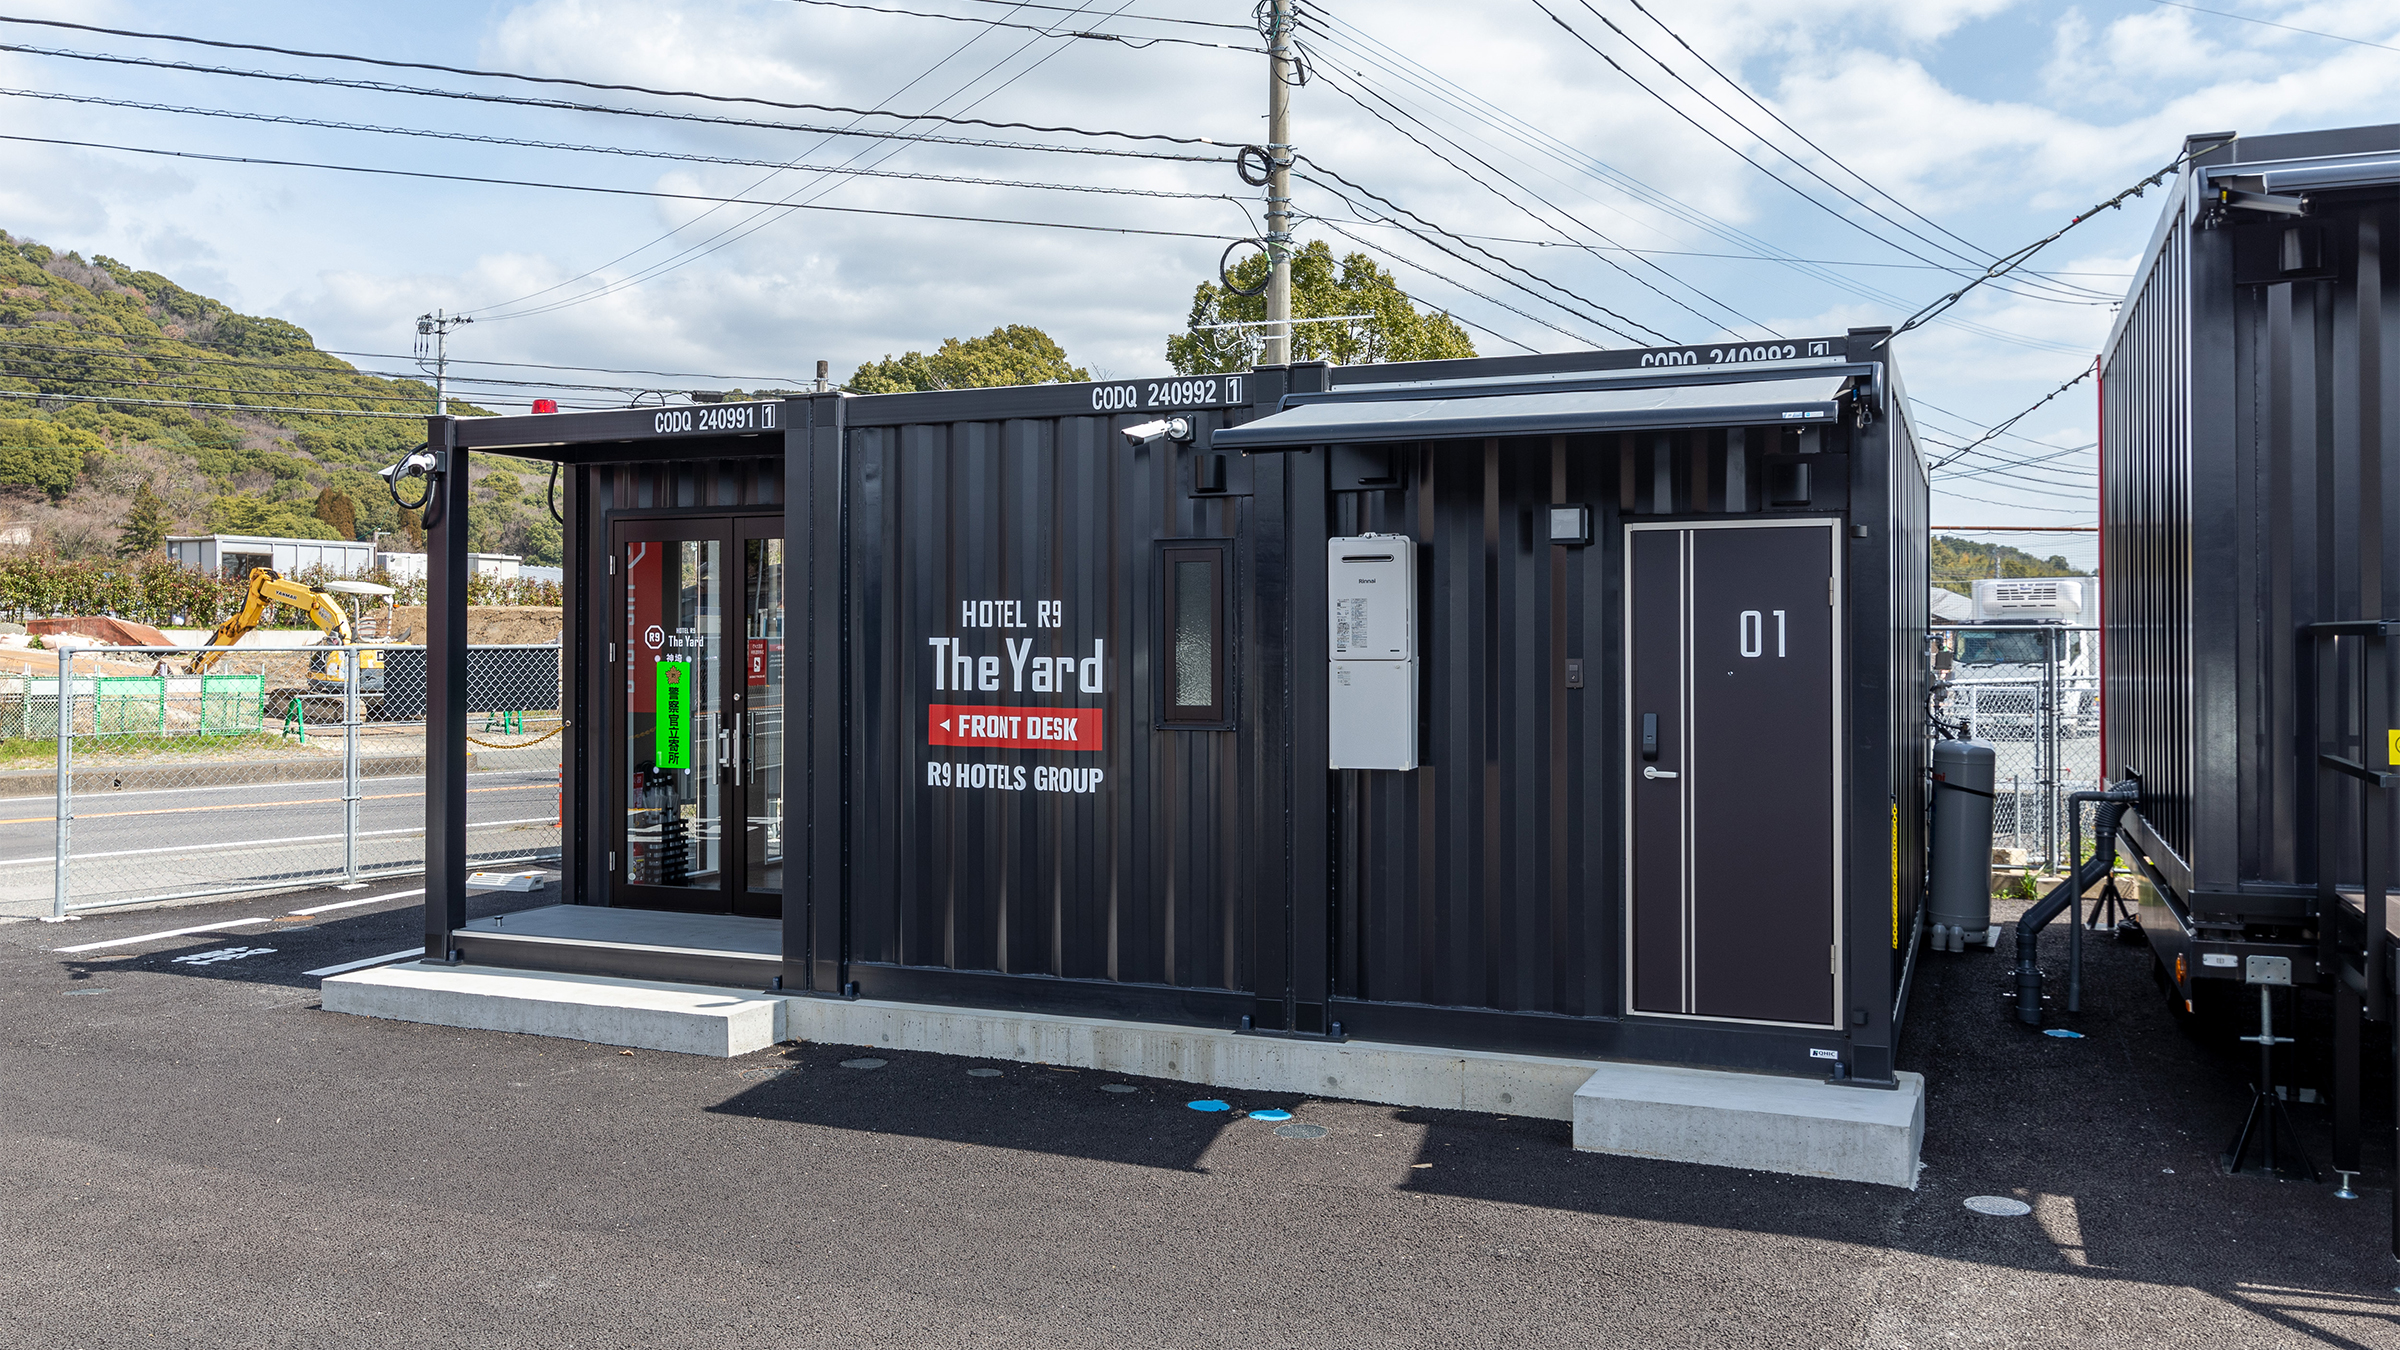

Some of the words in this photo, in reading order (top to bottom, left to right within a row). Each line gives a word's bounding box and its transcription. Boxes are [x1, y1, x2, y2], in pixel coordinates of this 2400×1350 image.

[1092, 385, 1137, 410] CODQ
[1148, 379, 1217, 406] 240992
[655, 411, 691, 433] CODQ
[699, 407, 754, 431] 240991
[276, 590, 297, 600] YANMAR
[962, 600, 1027, 628] HOTEL
[1037, 600, 1062, 628] R9
[649, 632, 661, 643] R9
[668, 635, 684, 648] The
[685, 635, 704, 648] Yard
[1740, 610, 1786, 658] 01
[929, 637, 1000, 691] The
[1005, 638, 1103, 693] Yard
[668, 687, 679, 765] 警察官立寄所
[958, 715, 1021, 740] FRONT
[1026, 716, 1078, 741] DESK
[928, 762, 951, 787] R9
[956, 763, 1026, 791] HOTELS
[1034, 766, 1104, 793] GROUP
